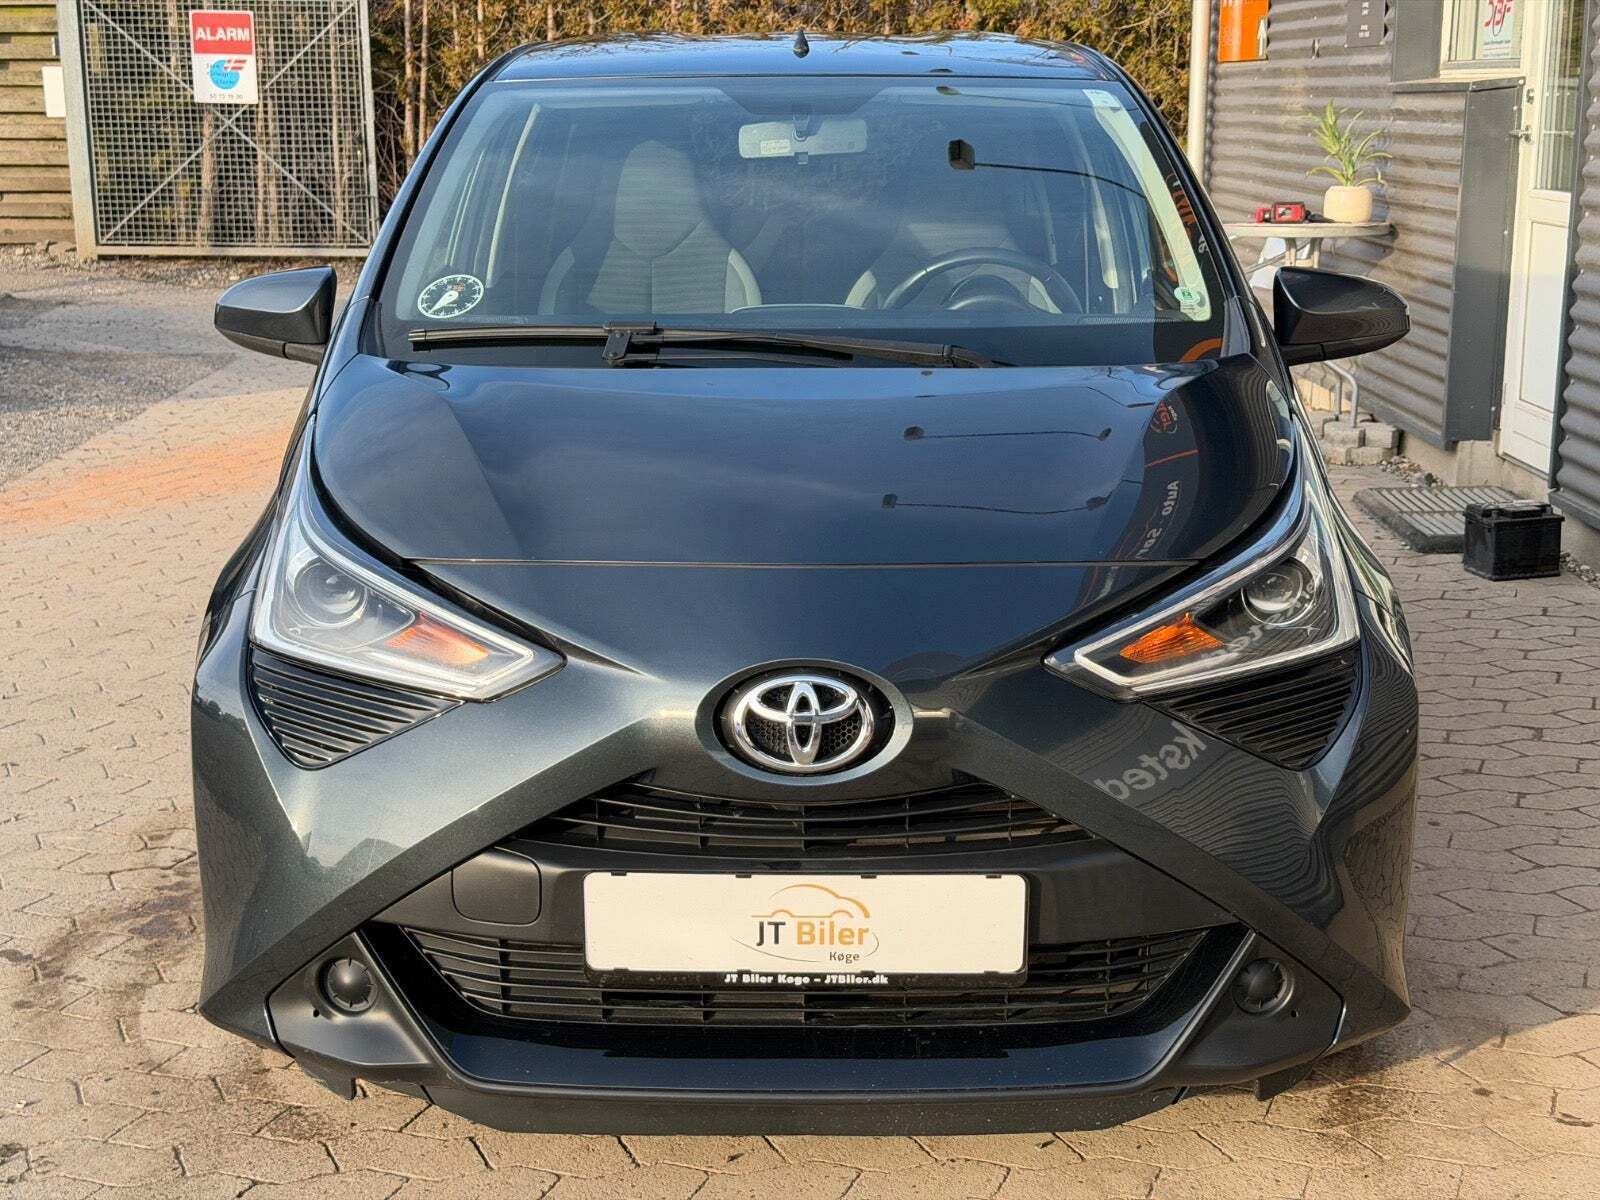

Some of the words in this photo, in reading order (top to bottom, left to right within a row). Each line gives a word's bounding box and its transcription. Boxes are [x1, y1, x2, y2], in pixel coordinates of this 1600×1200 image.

[195, 27, 251, 42] ALARM
[756, 921, 786, 947] JT
[796, 920, 870, 946] Biler
[829, 951, 860, 964] Køge
[724, 973, 738, 983] JT
[742, 973, 774, 983] Biler
